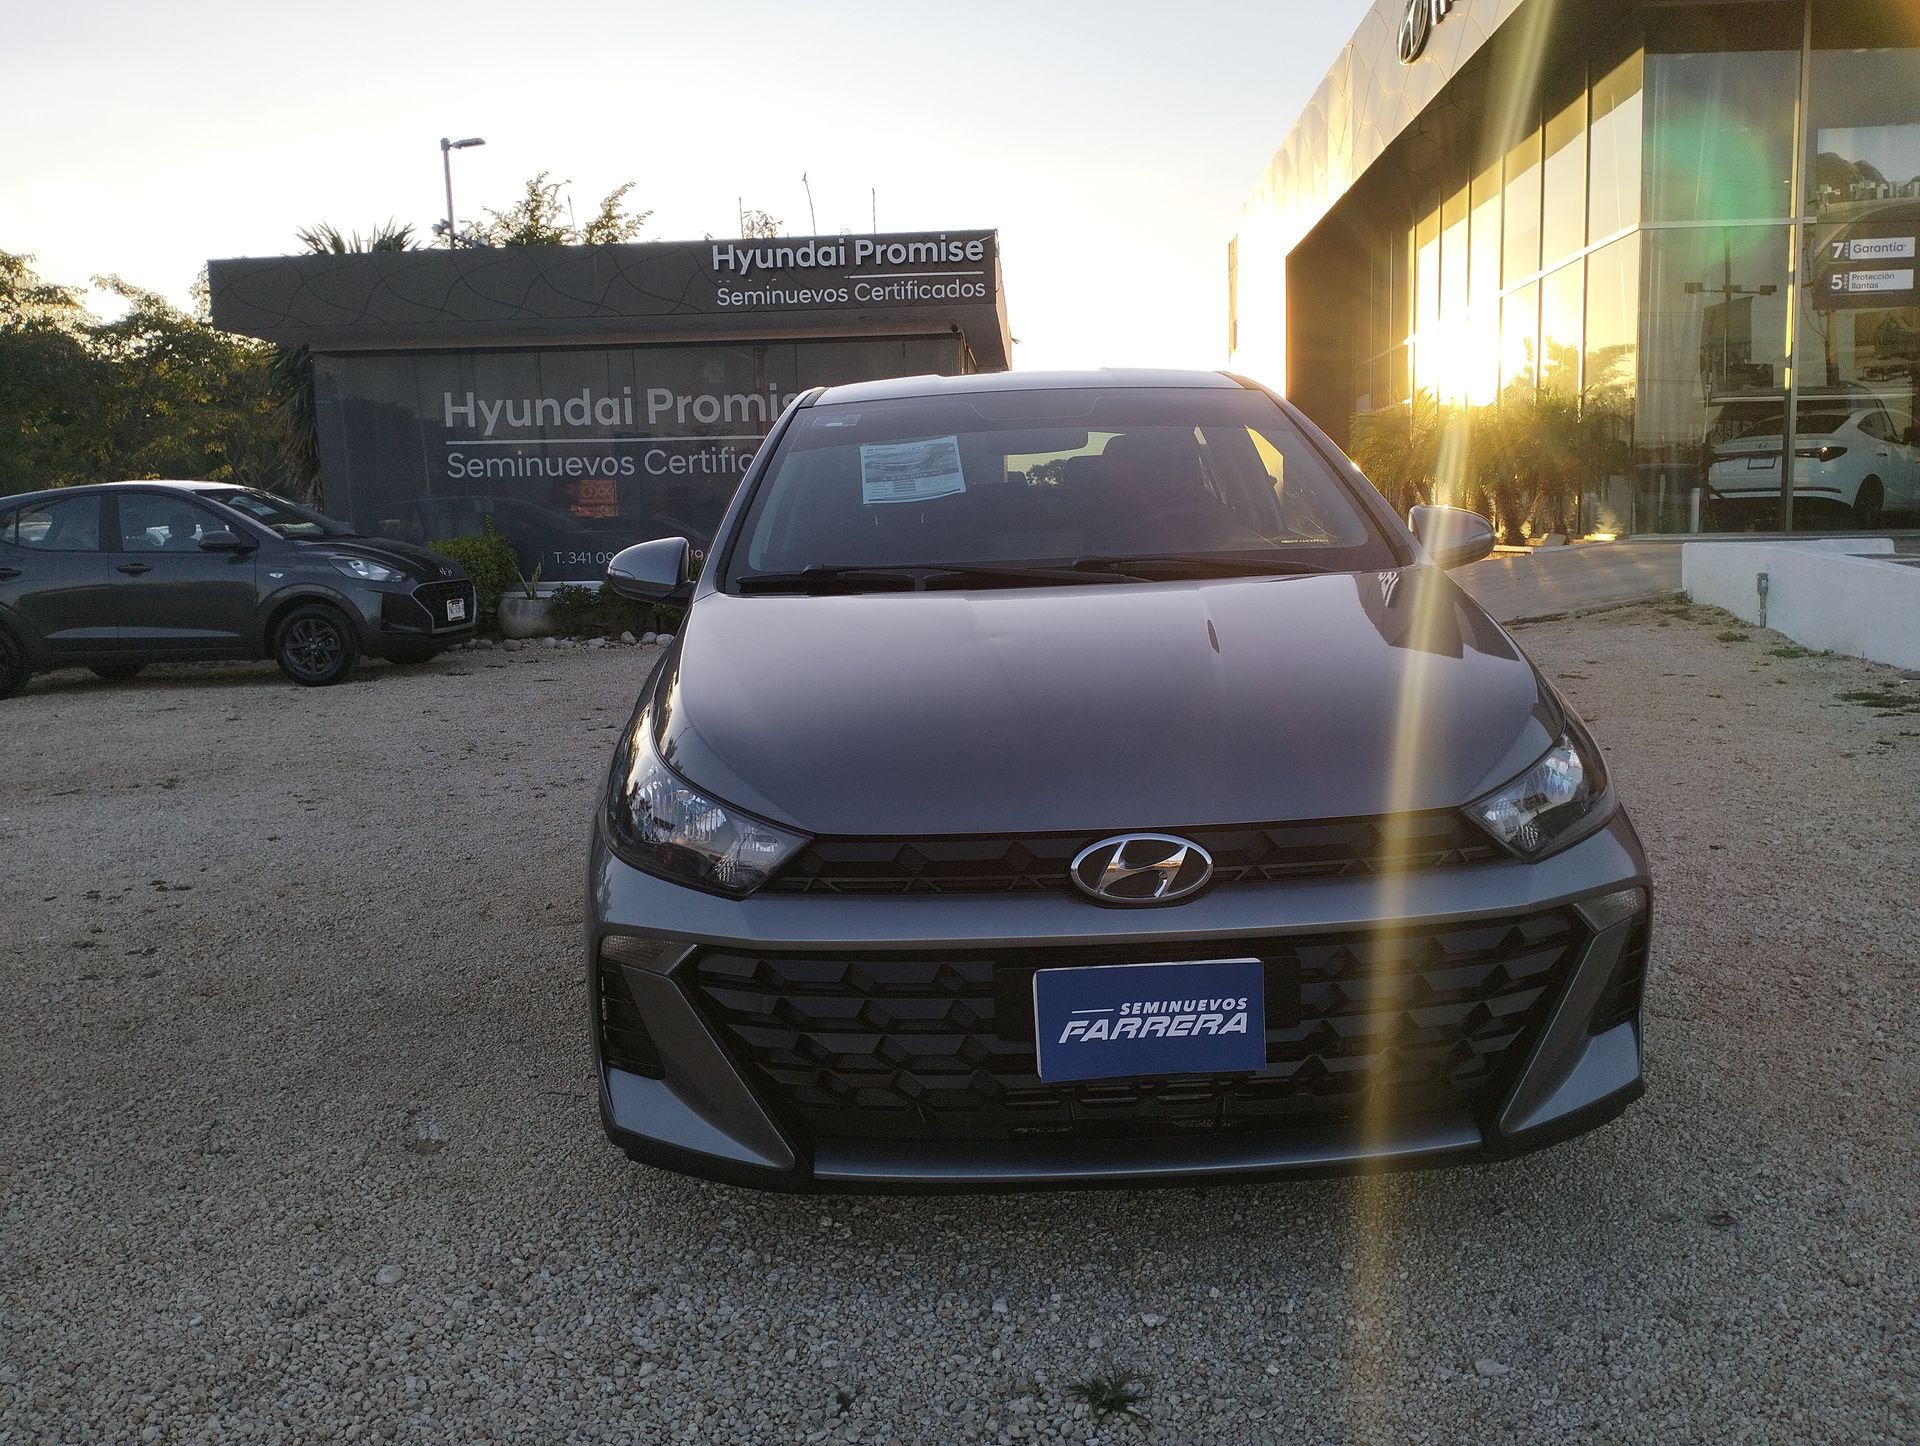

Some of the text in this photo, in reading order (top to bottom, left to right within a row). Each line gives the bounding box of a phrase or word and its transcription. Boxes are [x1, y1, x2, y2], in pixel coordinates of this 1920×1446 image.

[712, 234, 984, 275] Hyundai Promise
[1832, 242, 1844, 259] 7
[1853, 242, 1904, 254] Garantía
[1831, 274, 1843, 290] 5
[1851, 272, 1895, 281] Protección
[1851, 281, 1879, 289] llantas
[716, 278, 986, 306] Seminuevos Certificados
[444, 386, 633, 436] Hyundai
[447, 450, 635, 479] Seminuevos
[553, 551, 566, 564] T.
[568, 551, 591, 564] 341
[1119, 997, 1248, 1016] SEMINUEVOS
[1058, 1012, 1248, 1044] FARRERA
